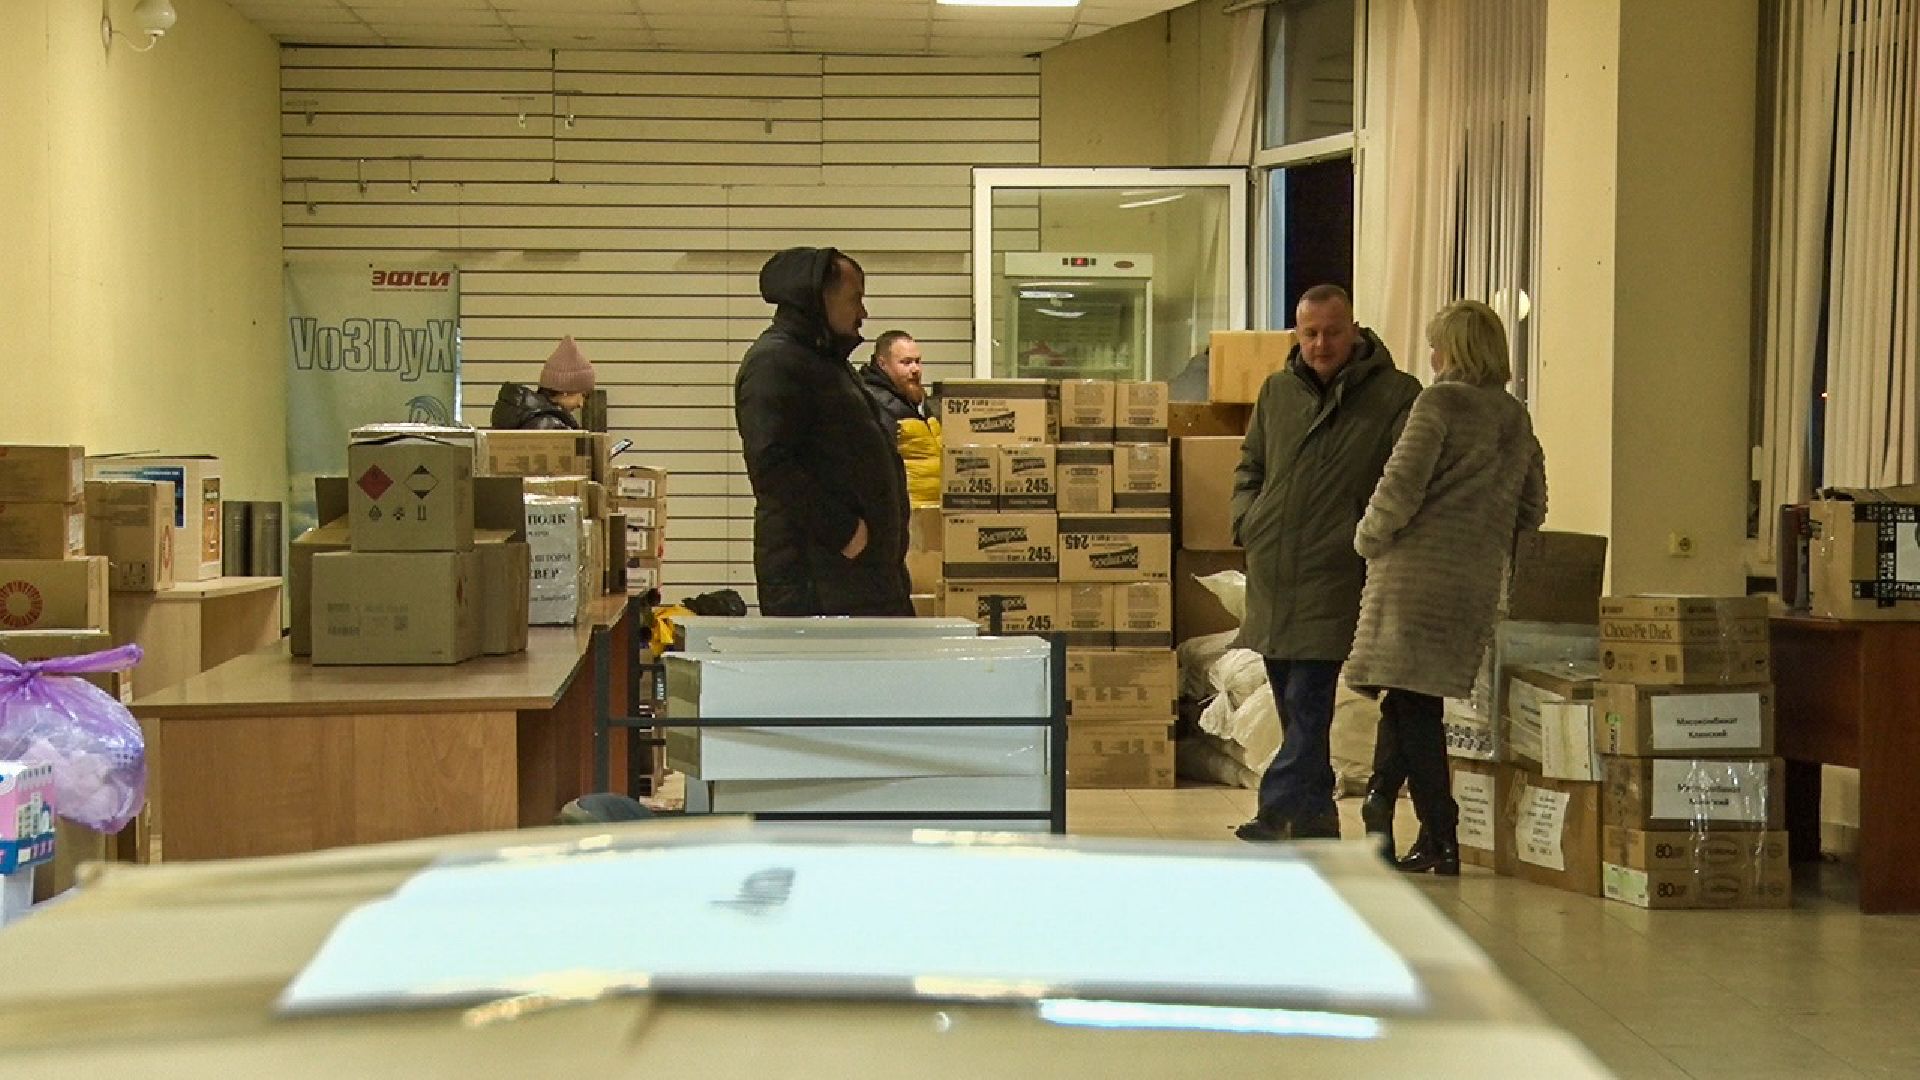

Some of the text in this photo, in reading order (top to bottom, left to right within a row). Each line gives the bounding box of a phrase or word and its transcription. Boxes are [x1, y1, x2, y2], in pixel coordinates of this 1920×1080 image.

[372, 270, 451, 287] ЭФСИ
[947, 399, 970, 415] 245
[968, 477, 992, 493] 245
[1025, 477, 1049, 493] 245
[1065, 534, 1090, 550] 245
[1028, 546, 1052, 562] 245
[1027, 614, 1051, 631] 245
[1650, 623, 1673, 640] Dark
[1655, 843, 1673, 859] 80
[1657, 882, 1675, 898] 80
